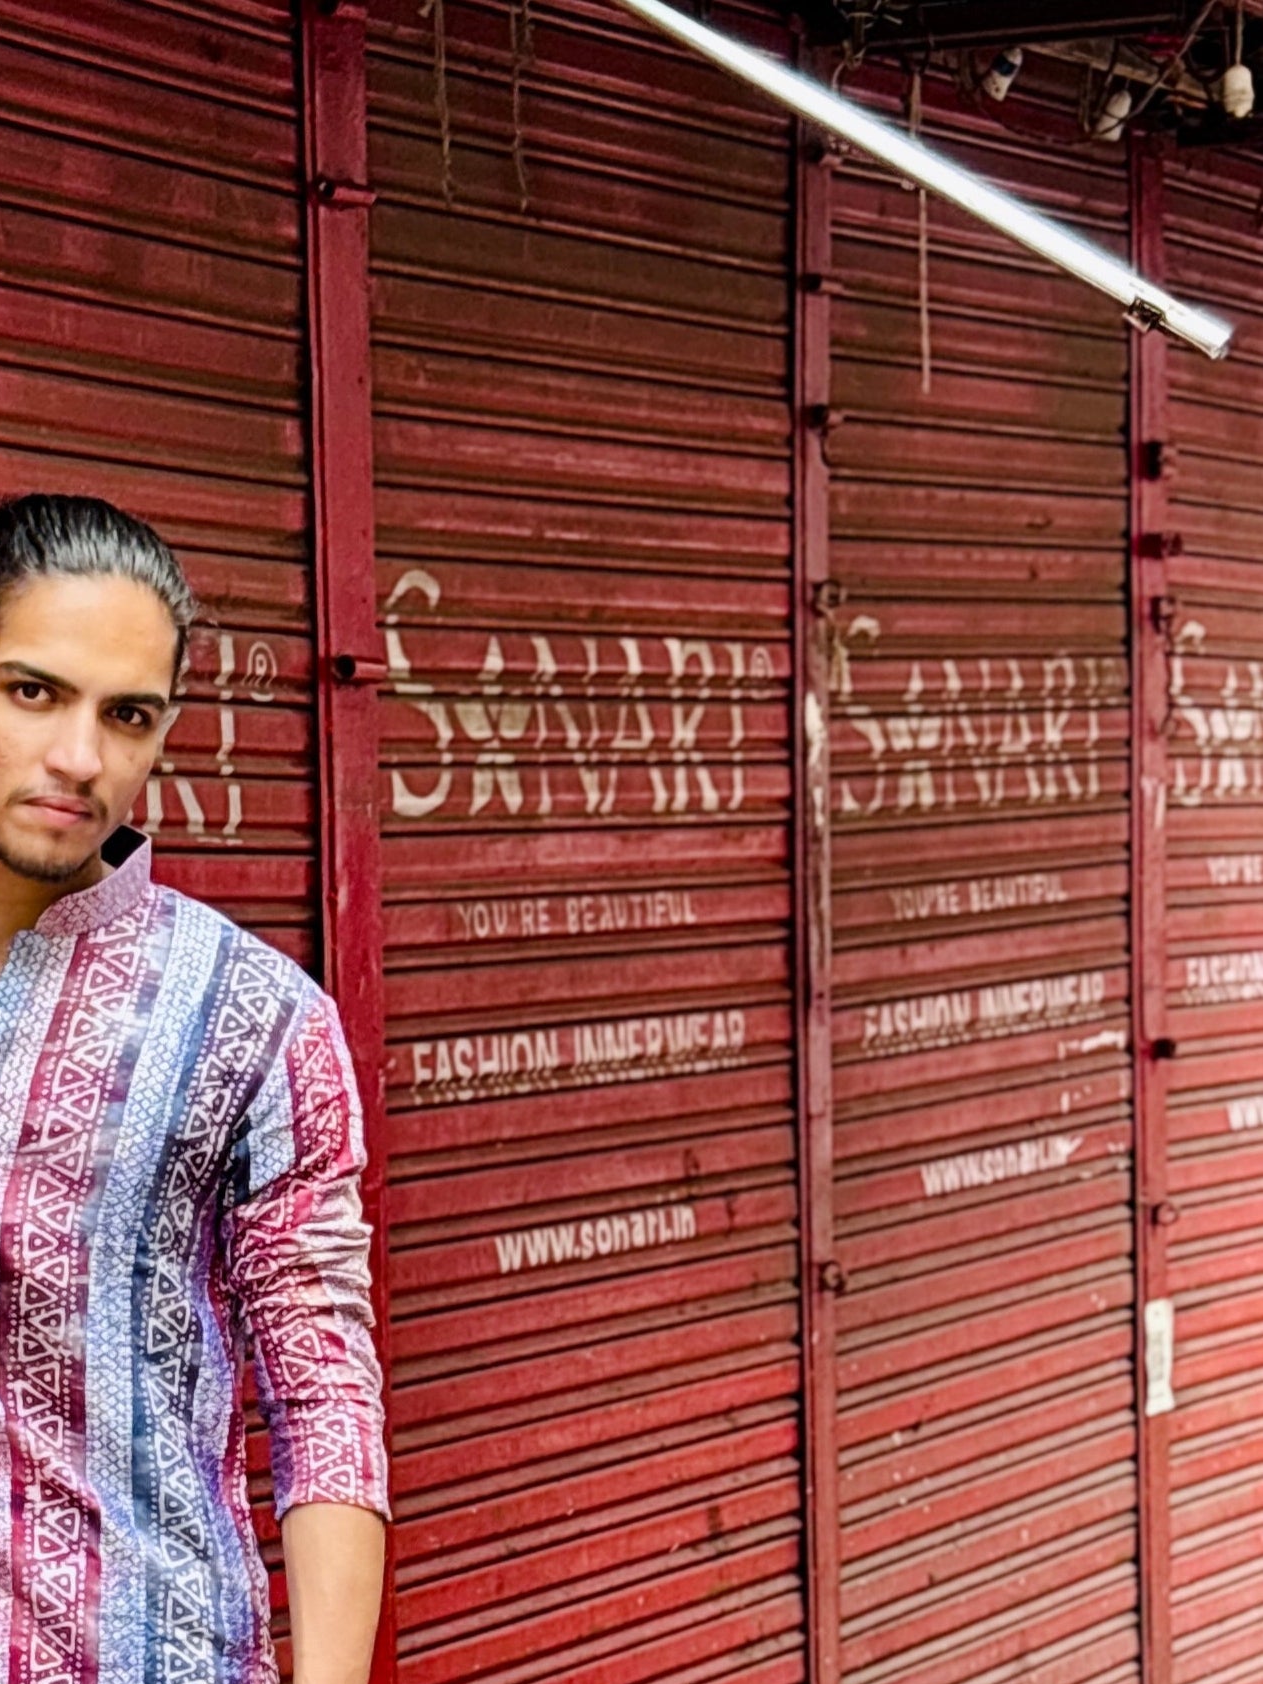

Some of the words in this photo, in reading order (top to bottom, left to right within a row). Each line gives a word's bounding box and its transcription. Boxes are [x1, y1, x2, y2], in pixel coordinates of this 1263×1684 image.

[457, 899, 551, 941] YOU'RE
[566, 891, 697, 934] BEAUTIFUL
[890, 882, 960, 921] YOU'RE
[968, 873, 1069, 913] BEAUTIFUL
[861, 990, 971, 1058] FASHION
[978, 971, 1106, 1041] INNERWEAR
[410, 1030, 559, 1105] FASHION
[571, 1010, 748, 1086] INNERWEAR
